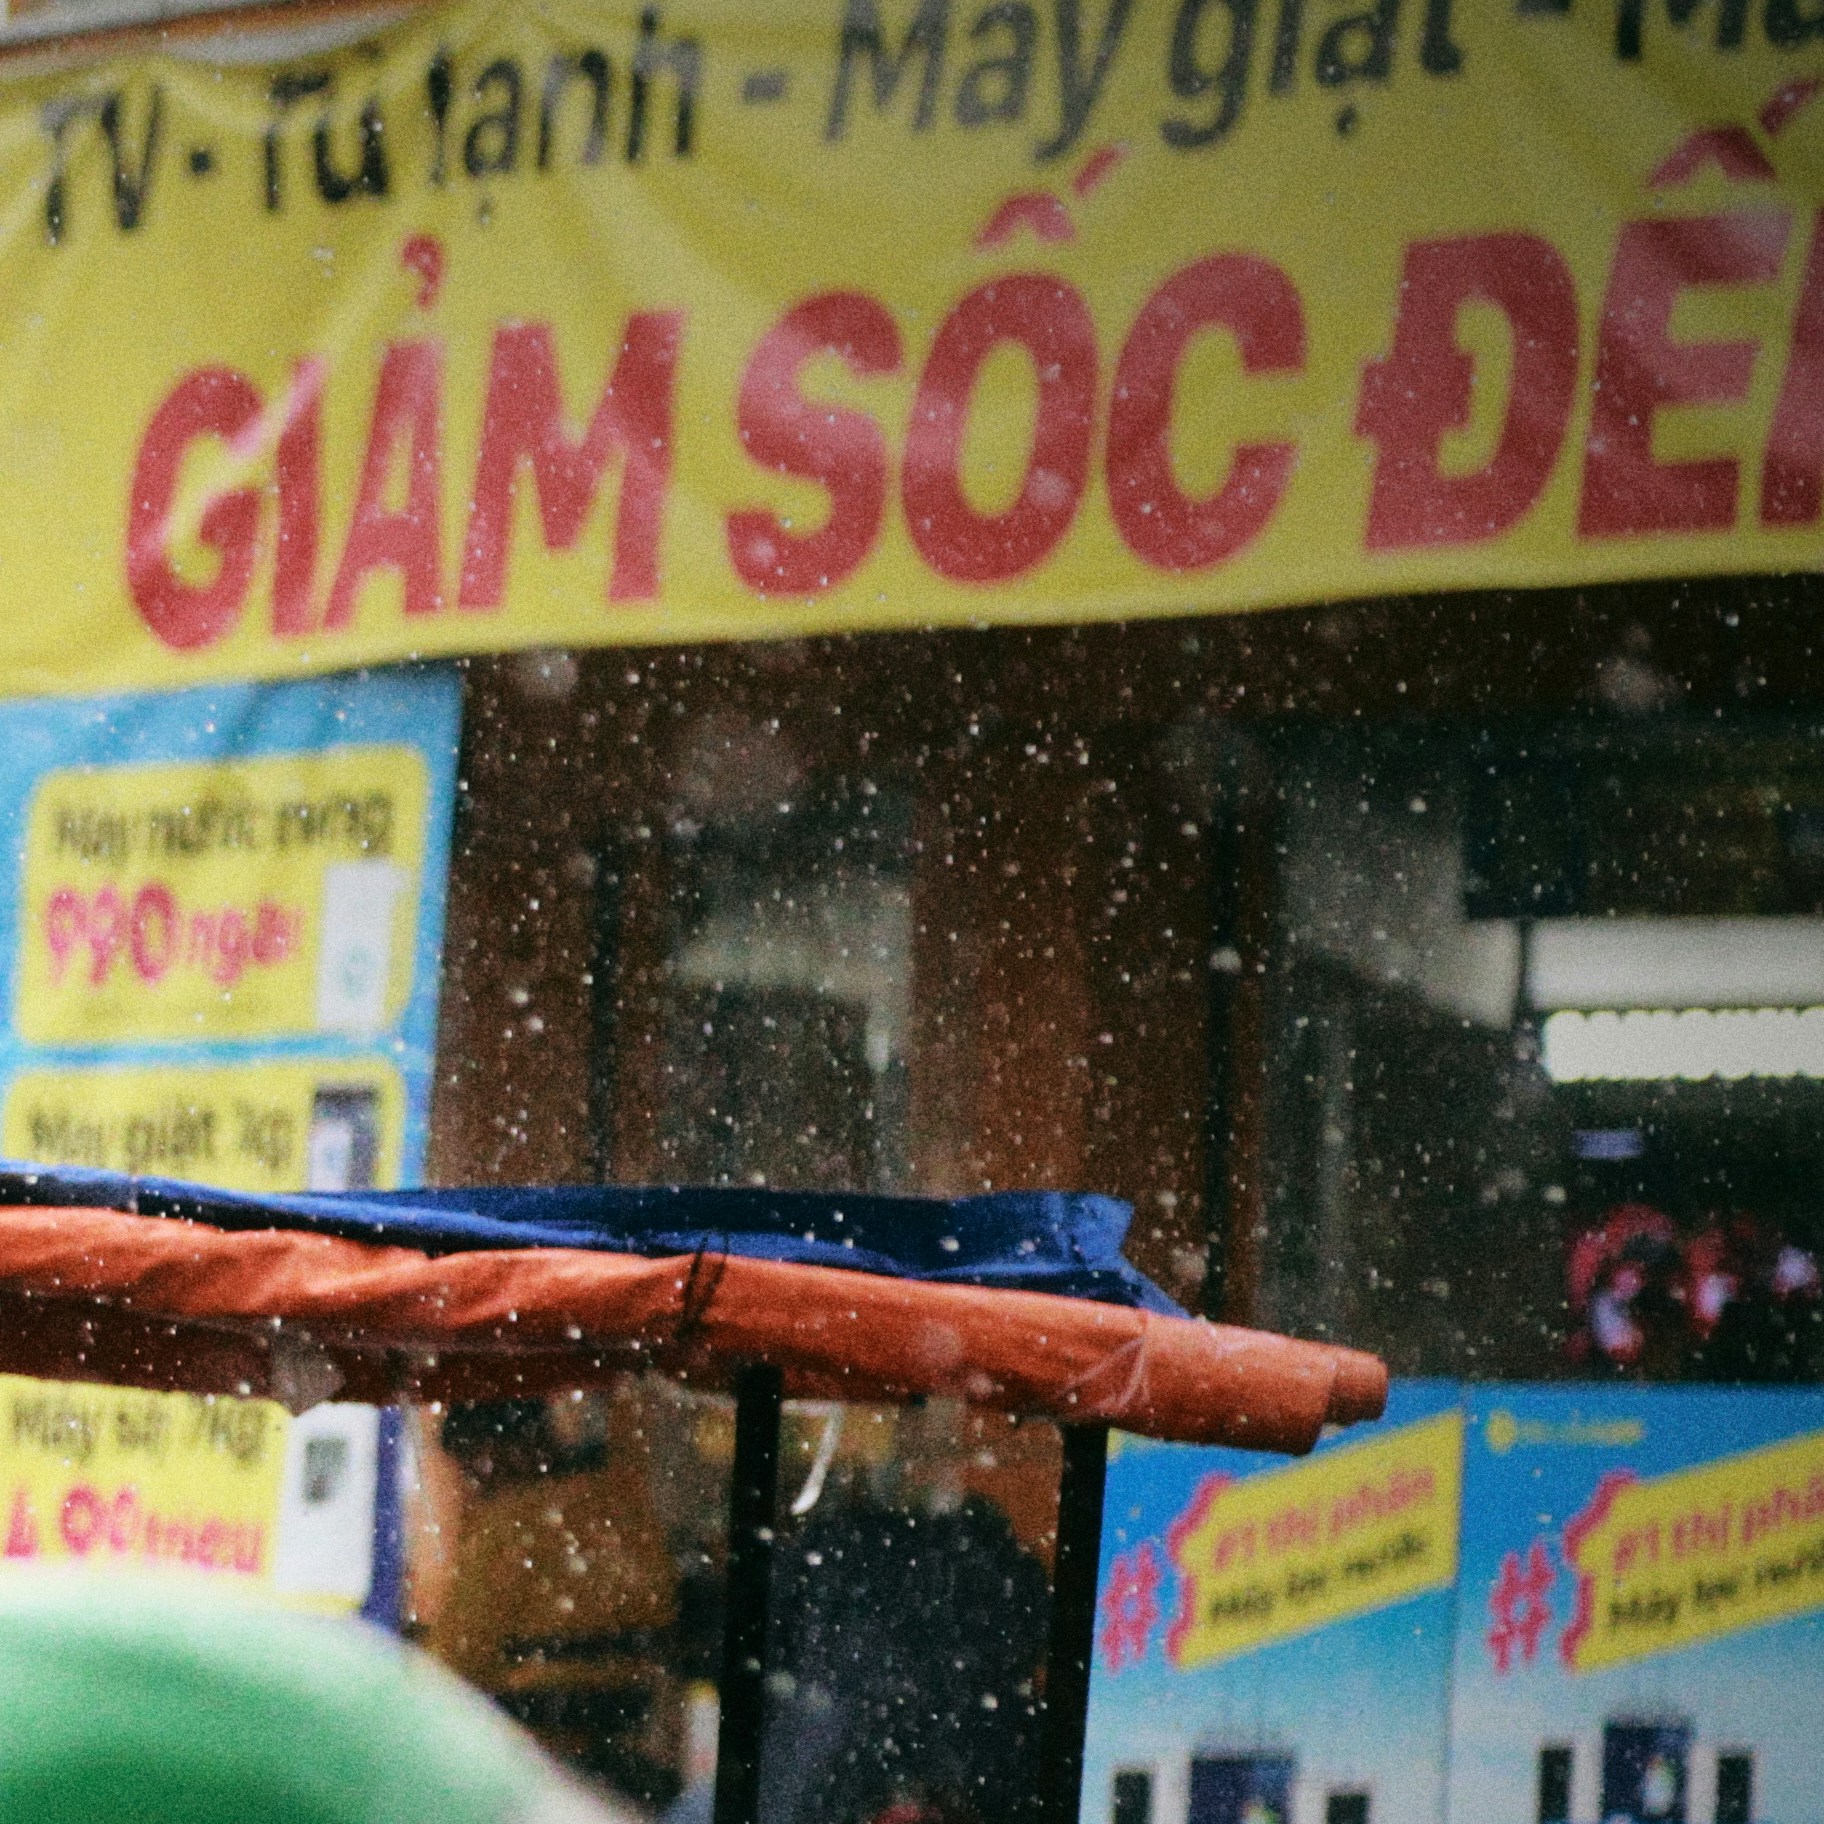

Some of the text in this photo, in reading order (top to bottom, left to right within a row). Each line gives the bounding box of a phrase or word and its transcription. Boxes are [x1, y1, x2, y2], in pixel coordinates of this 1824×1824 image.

[40, 84, 164, 246] TV
[424, 5, 702, 226] lạnh
[124, 76, 1824, 650] GIẢM SỐC ĐẾ
